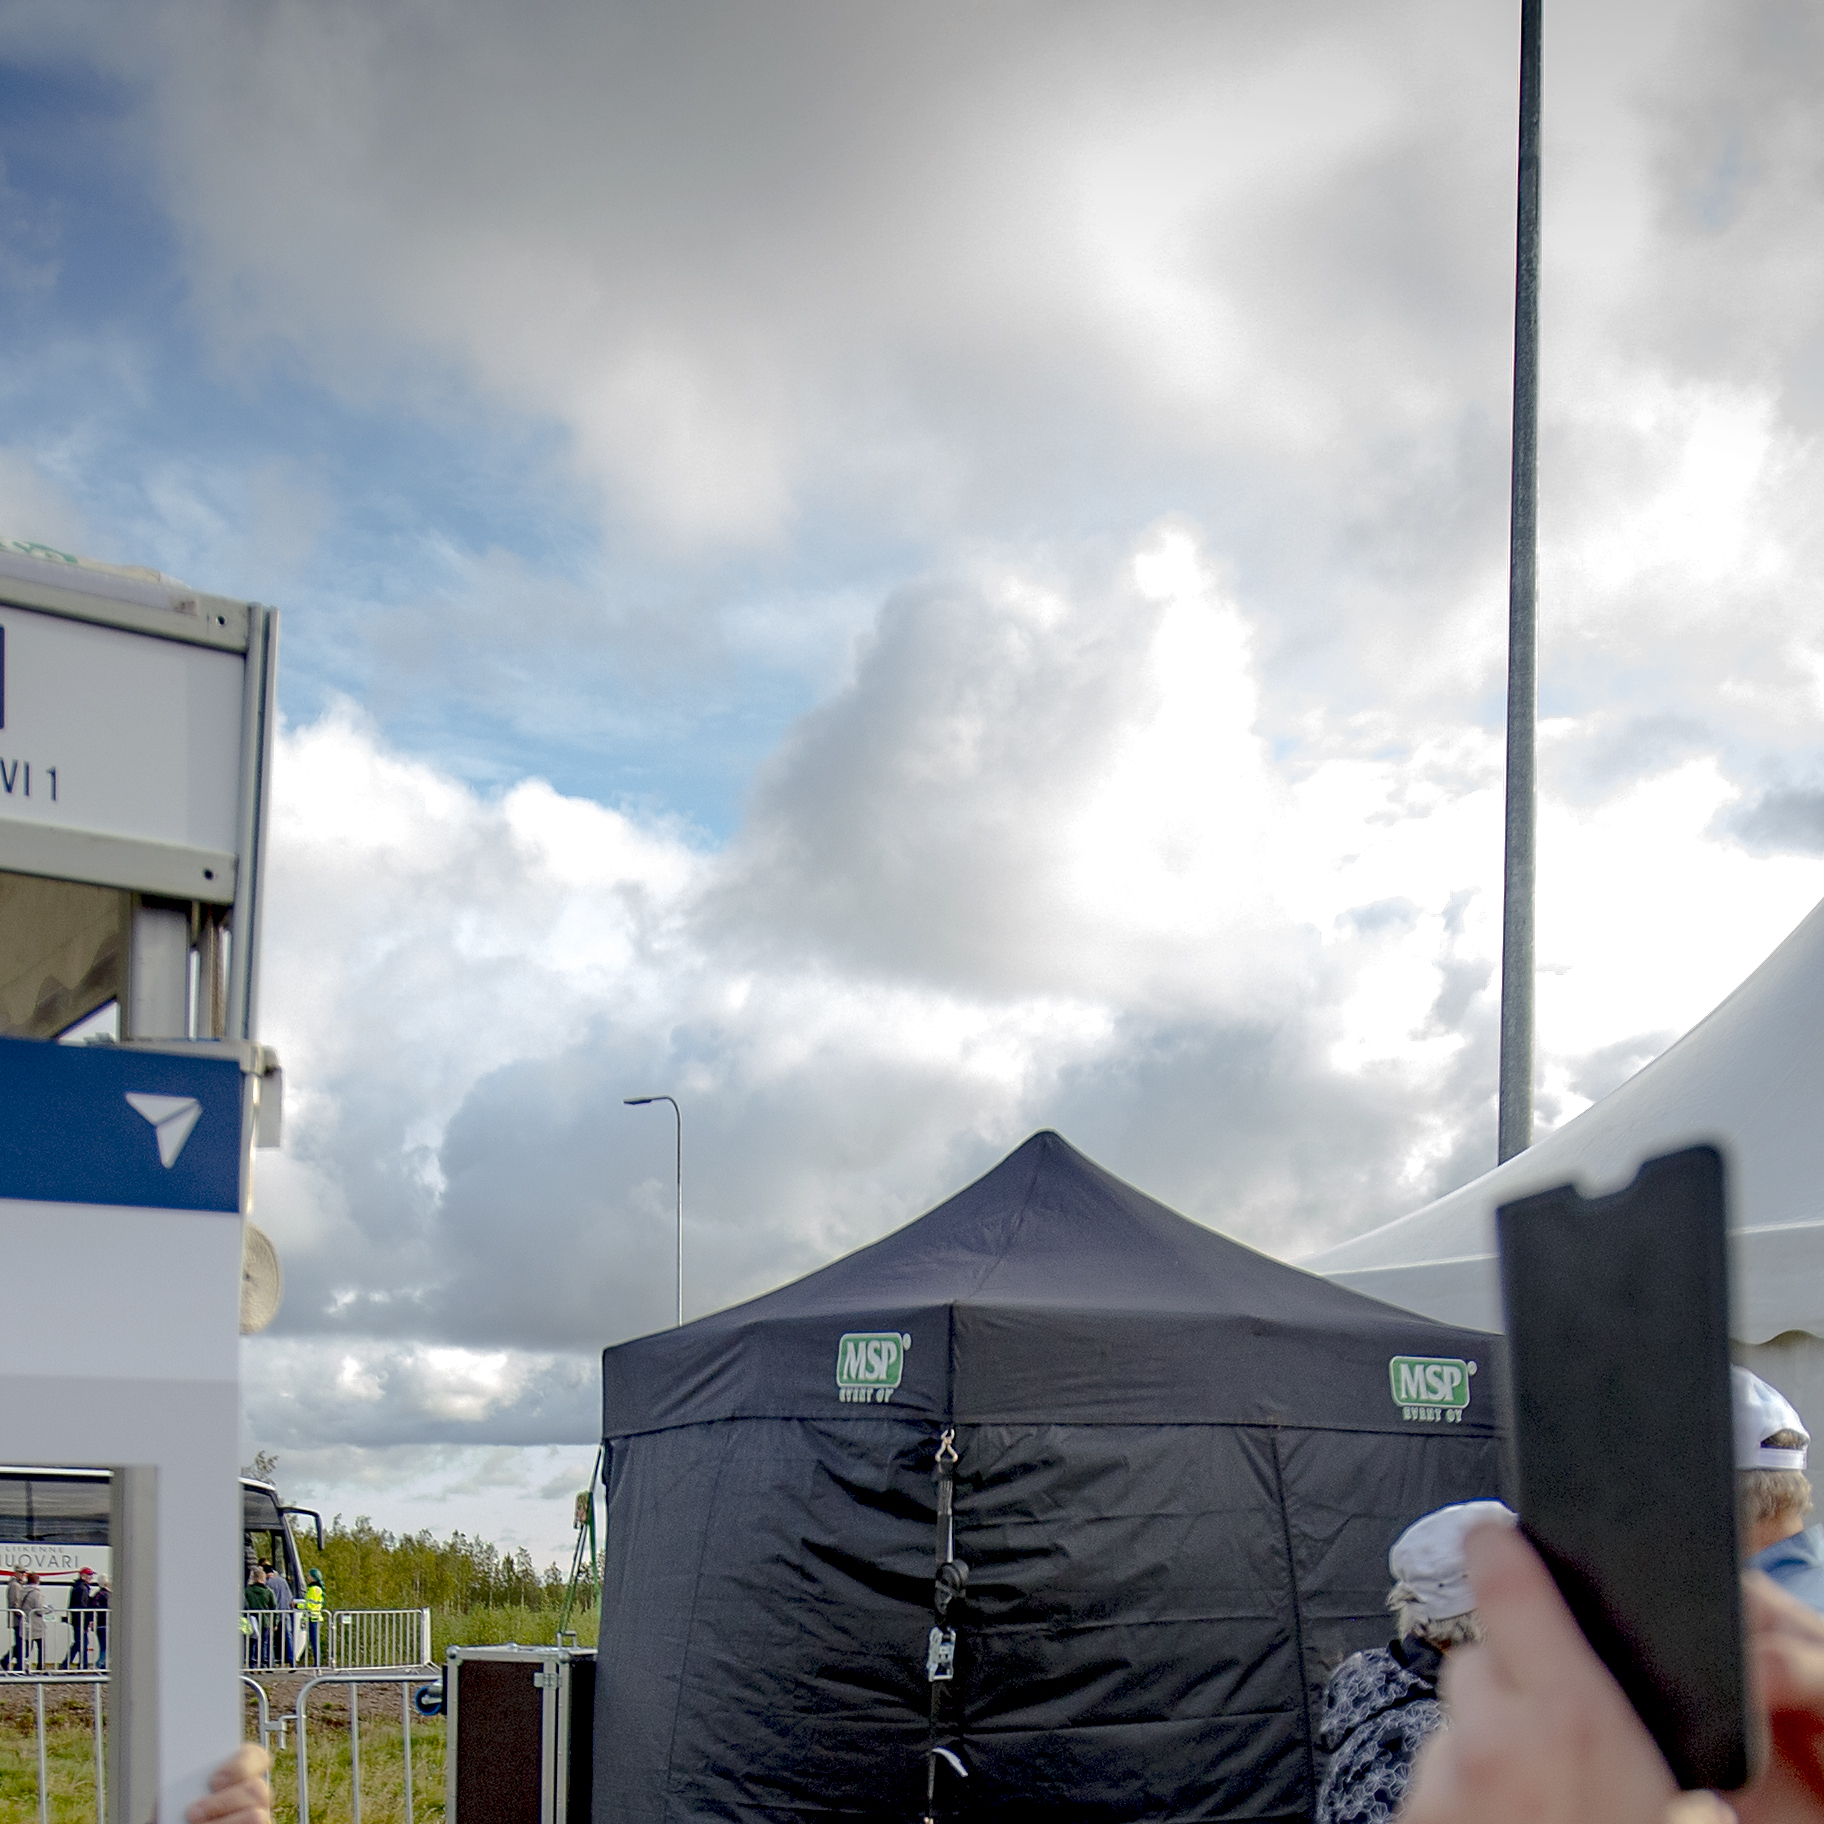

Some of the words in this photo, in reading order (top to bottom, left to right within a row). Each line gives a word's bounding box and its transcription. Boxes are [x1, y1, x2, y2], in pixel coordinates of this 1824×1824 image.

[45, 765, 57, 802] 1
[842, 1340, 898, 1381] MSP
[1399, 1363, 1463, 1402] MSP
[1401, 1406, 1442, 1423] EVENT
[5, 1545, 65, 1554] LIIKENNE
